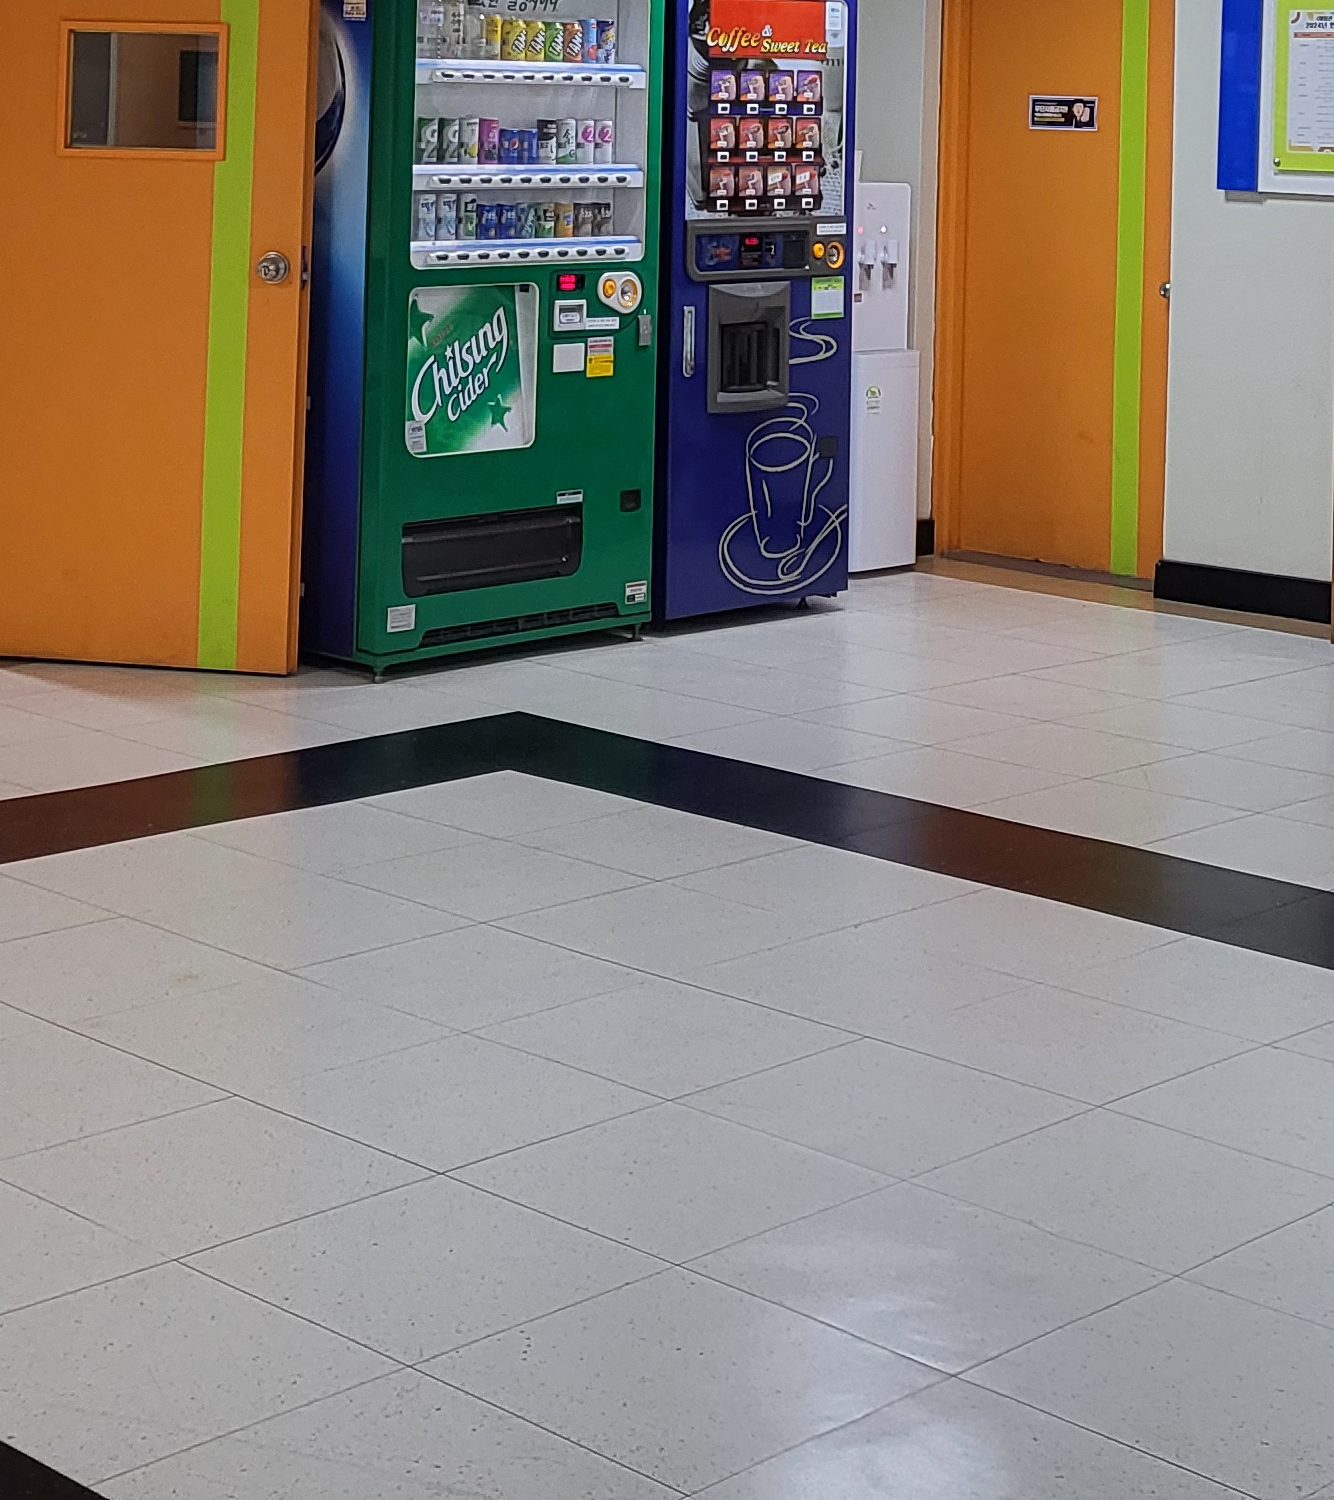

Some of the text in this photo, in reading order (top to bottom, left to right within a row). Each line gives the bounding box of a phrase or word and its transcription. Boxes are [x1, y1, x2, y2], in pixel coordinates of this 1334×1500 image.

[706, 27, 760, 52] Coffee
[761, 38, 800, 53] Sweet
[804, 41, 827, 53] Tea
[412, 307, 509, 424] Chilsung
